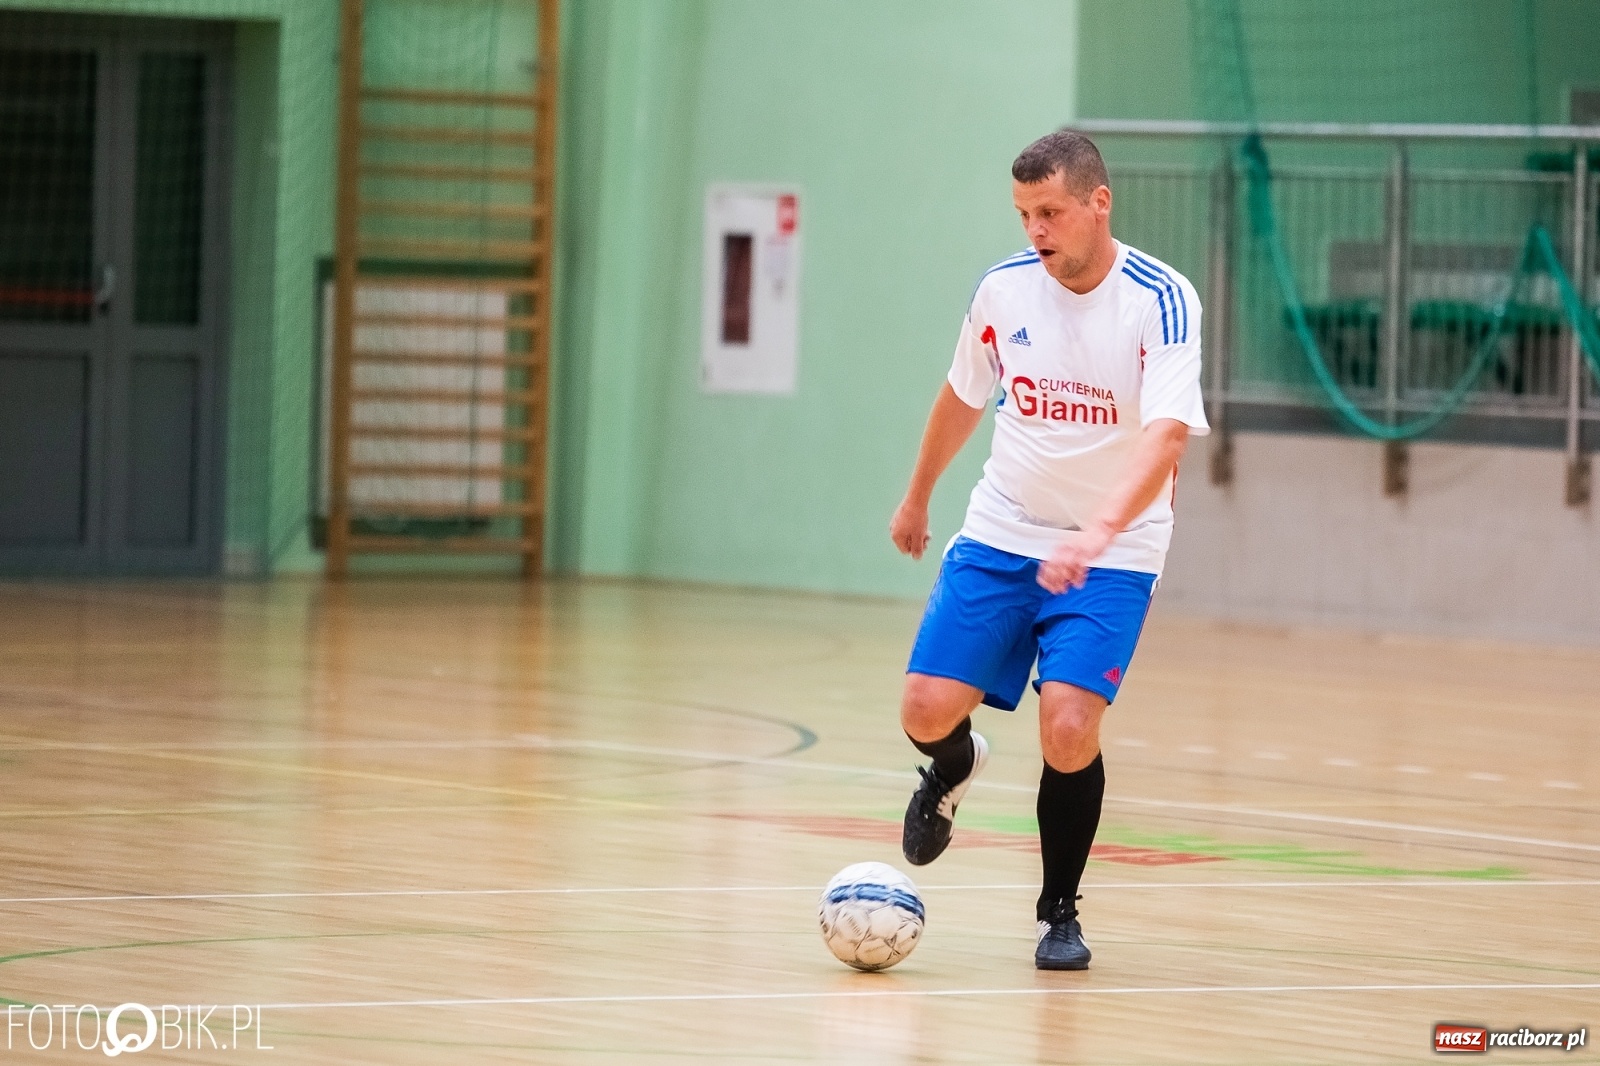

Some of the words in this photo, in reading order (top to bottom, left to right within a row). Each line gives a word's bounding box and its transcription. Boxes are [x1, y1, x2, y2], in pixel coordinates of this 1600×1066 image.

[1008, 336, 1031, 347] adidas
[1011, 375, 1118, 425] Gianni
[1038, 378, 1115, 402] CUKIERNIA
